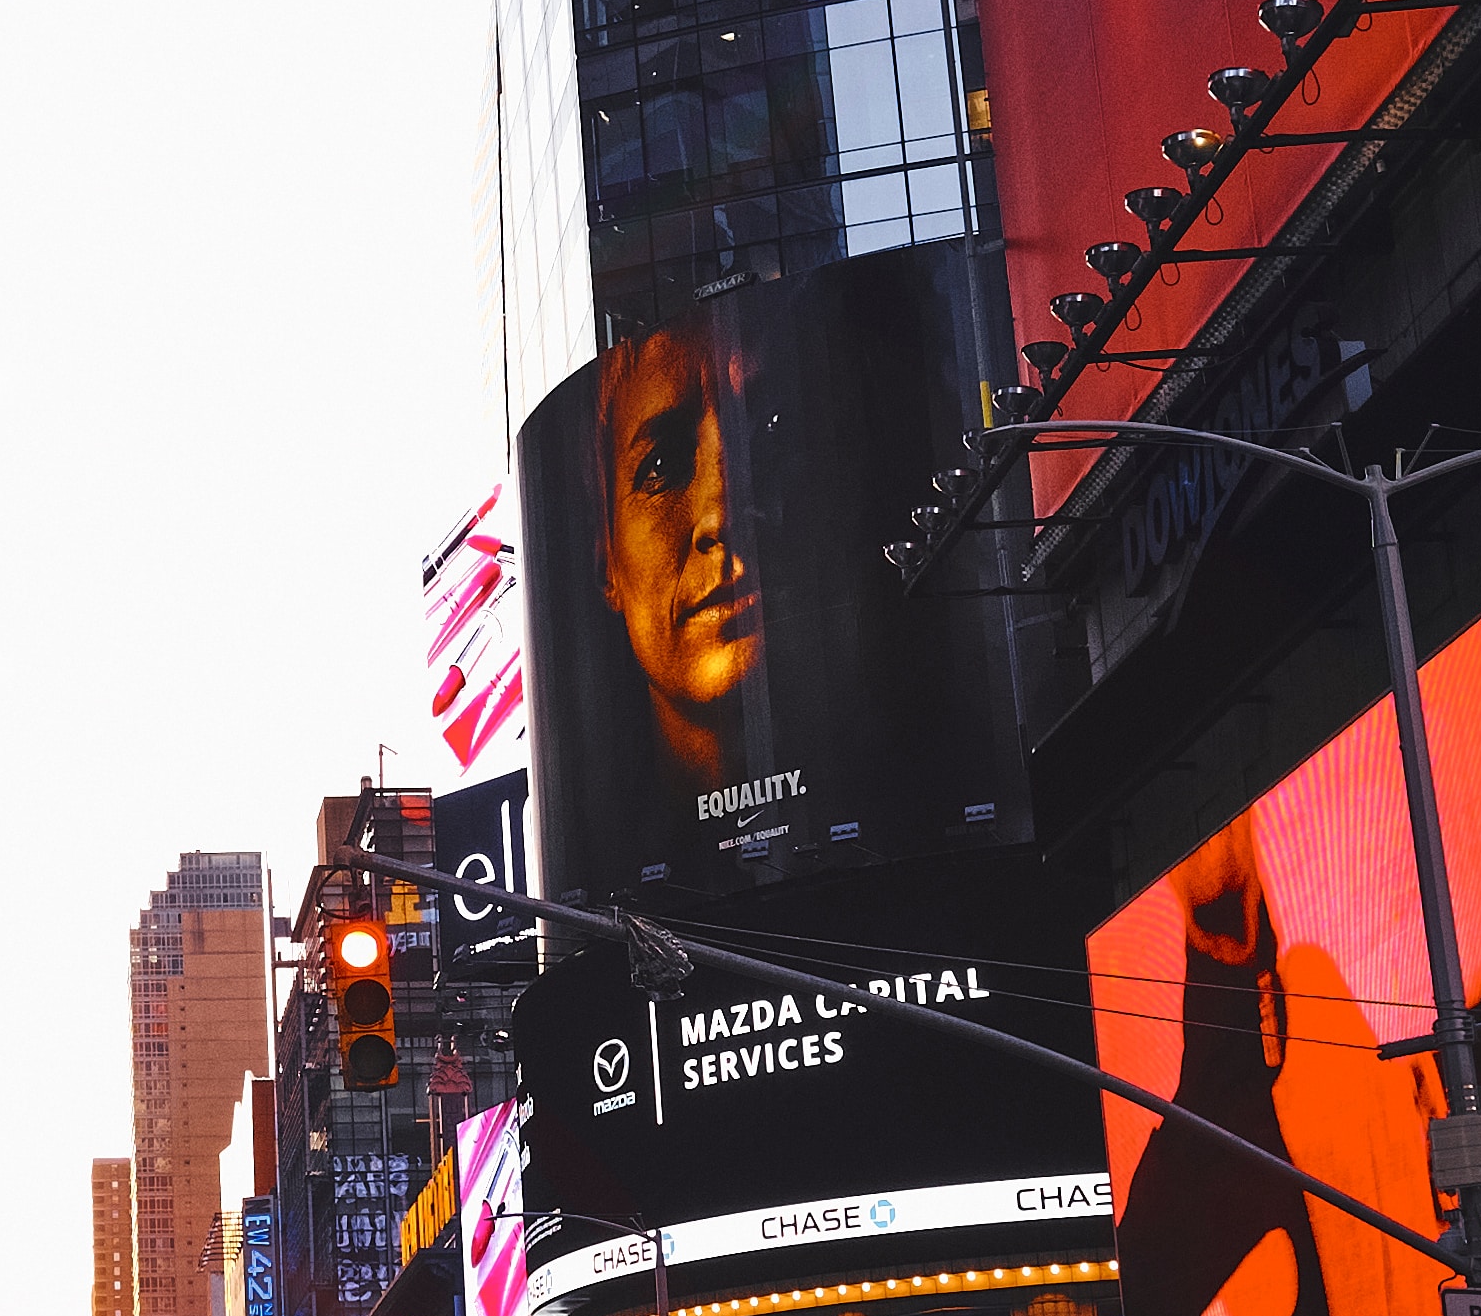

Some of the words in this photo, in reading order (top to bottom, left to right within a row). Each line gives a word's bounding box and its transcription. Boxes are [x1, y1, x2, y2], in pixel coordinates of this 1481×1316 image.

[697, 769, 808, 821] EQUALITY.
[680, 993, 804, 1046] MAZDA
[682, 1031, 845, 1090] SERVICES
[761, 1205, 861, 1240] CHASE
[593, 1239, 654, 1274] CHASE
